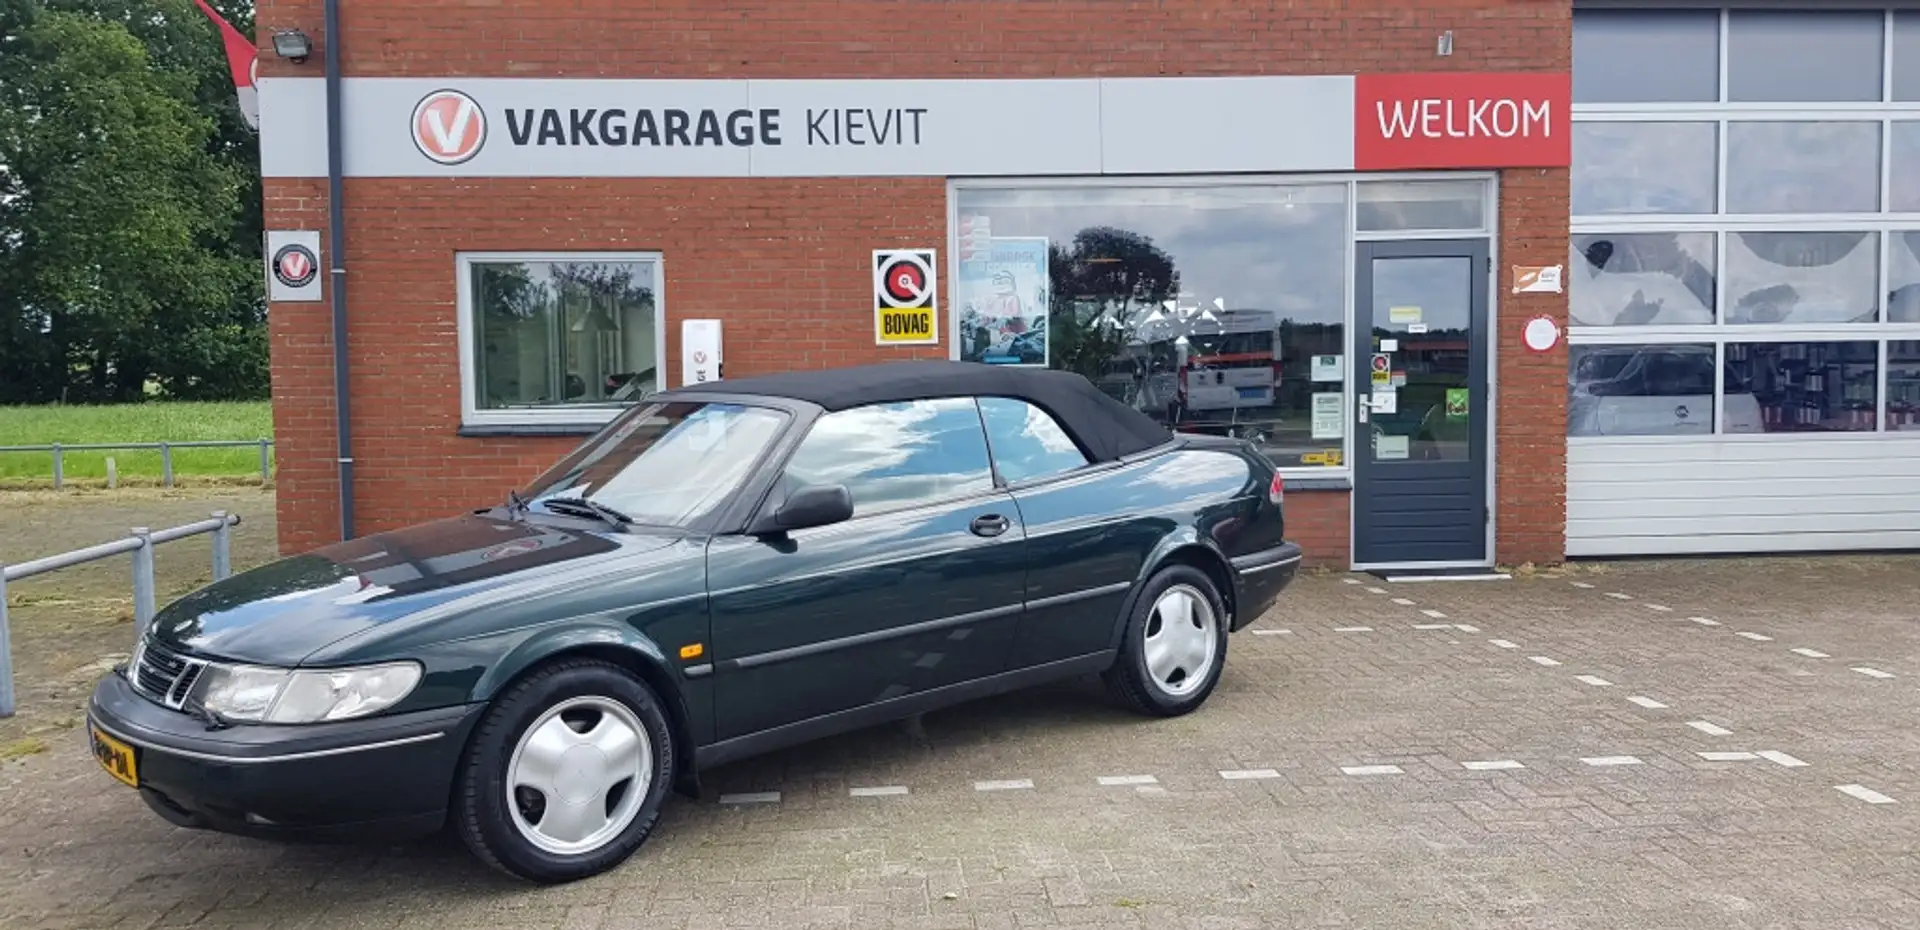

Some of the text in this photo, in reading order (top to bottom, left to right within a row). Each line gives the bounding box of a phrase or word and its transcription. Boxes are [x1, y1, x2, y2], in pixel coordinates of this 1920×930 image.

[505, 108, 928, 146] VAKGARAGE KIEVIT
[1376, 99, 1550, 139] WELKOM
[884, 312, 929, 335] BOVAG
